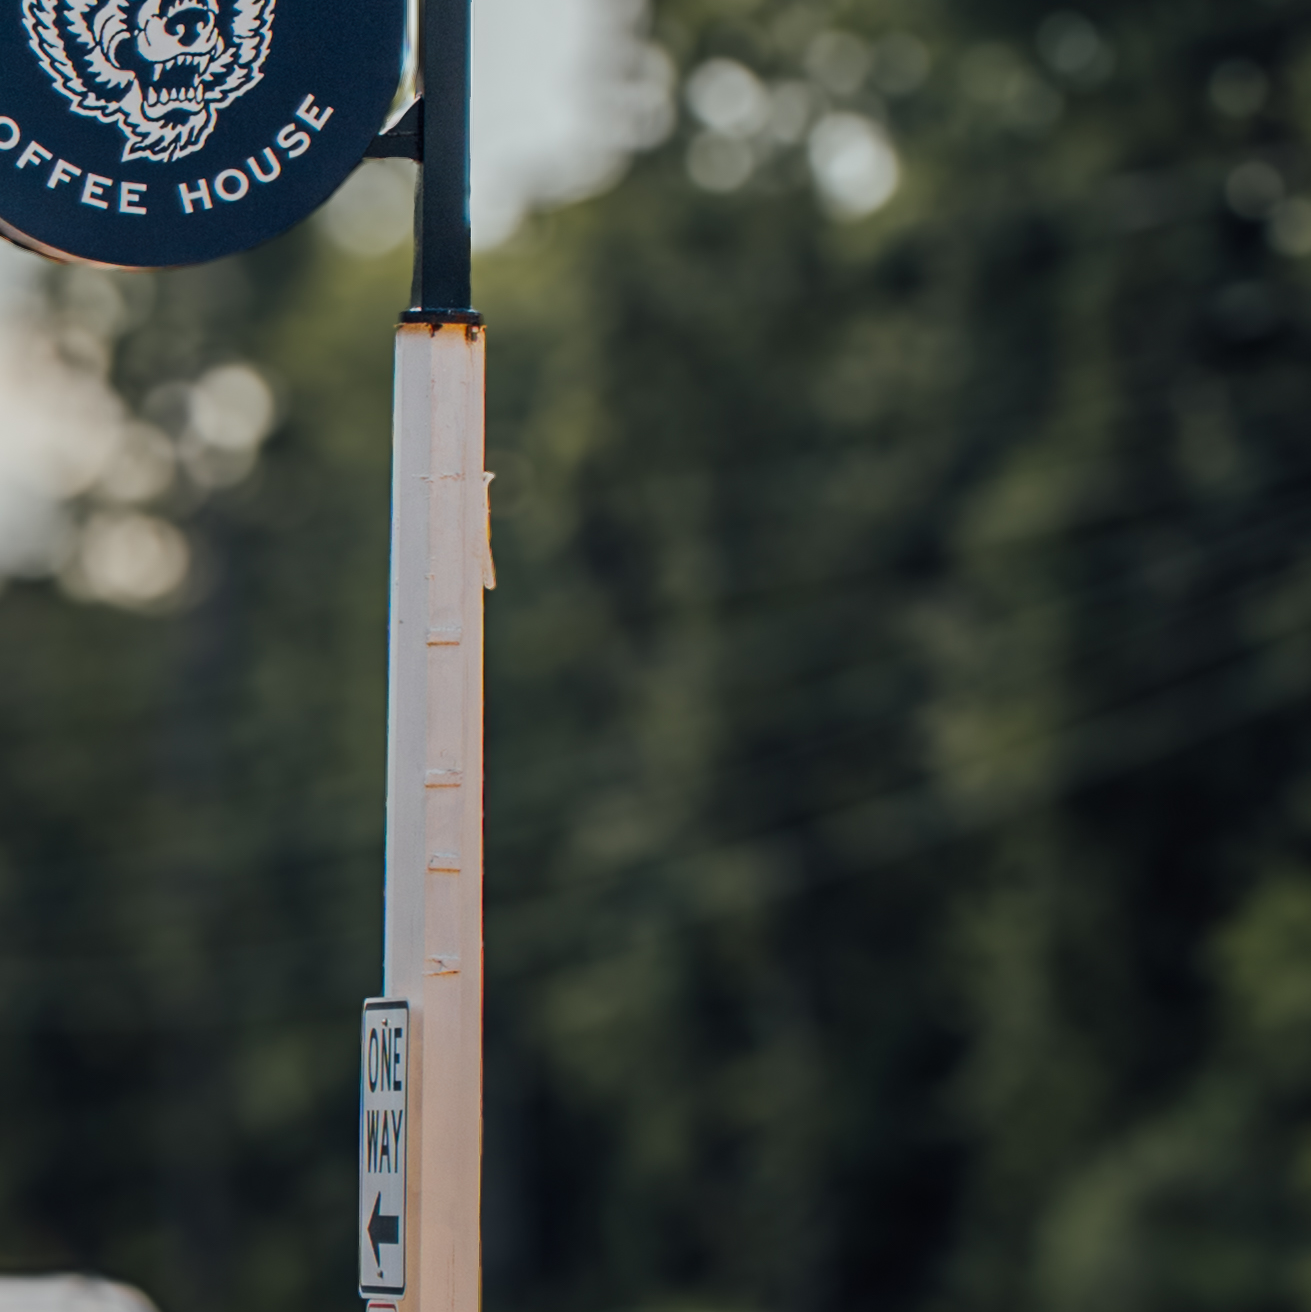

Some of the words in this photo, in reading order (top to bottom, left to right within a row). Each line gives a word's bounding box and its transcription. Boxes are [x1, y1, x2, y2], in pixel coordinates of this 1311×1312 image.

[178, 92, 334, 214] HOUSE
[367, 1027, 403, 1094] ONE
[366, 1109, 404, 1175] WAY
